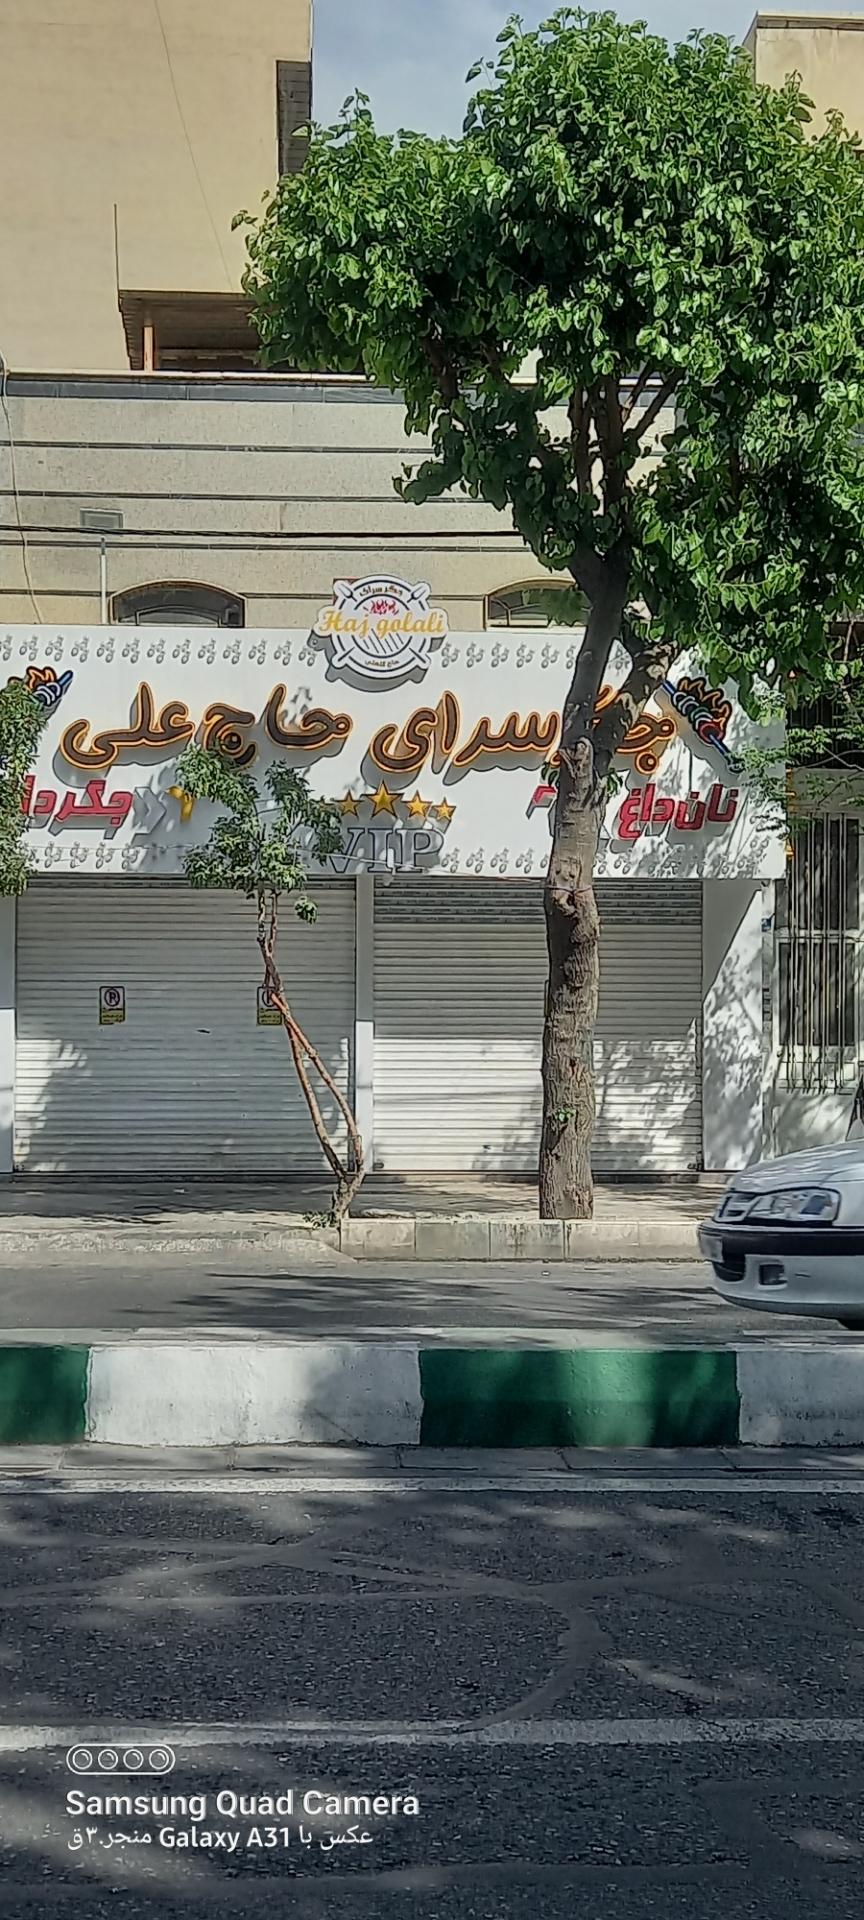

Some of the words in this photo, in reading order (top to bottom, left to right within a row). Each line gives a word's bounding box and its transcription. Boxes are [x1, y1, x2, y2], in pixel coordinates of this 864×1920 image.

[319, 610, 370, 639] Haj
[376, 612, 444, 639] golali
[60, 681, 195, 770] علی
[197, 682, 353, 768] حاج
[618, 783, 674, 839] داغ
[673, 783, 739, 830] نان
[329, 827, 445, 873] VIP
